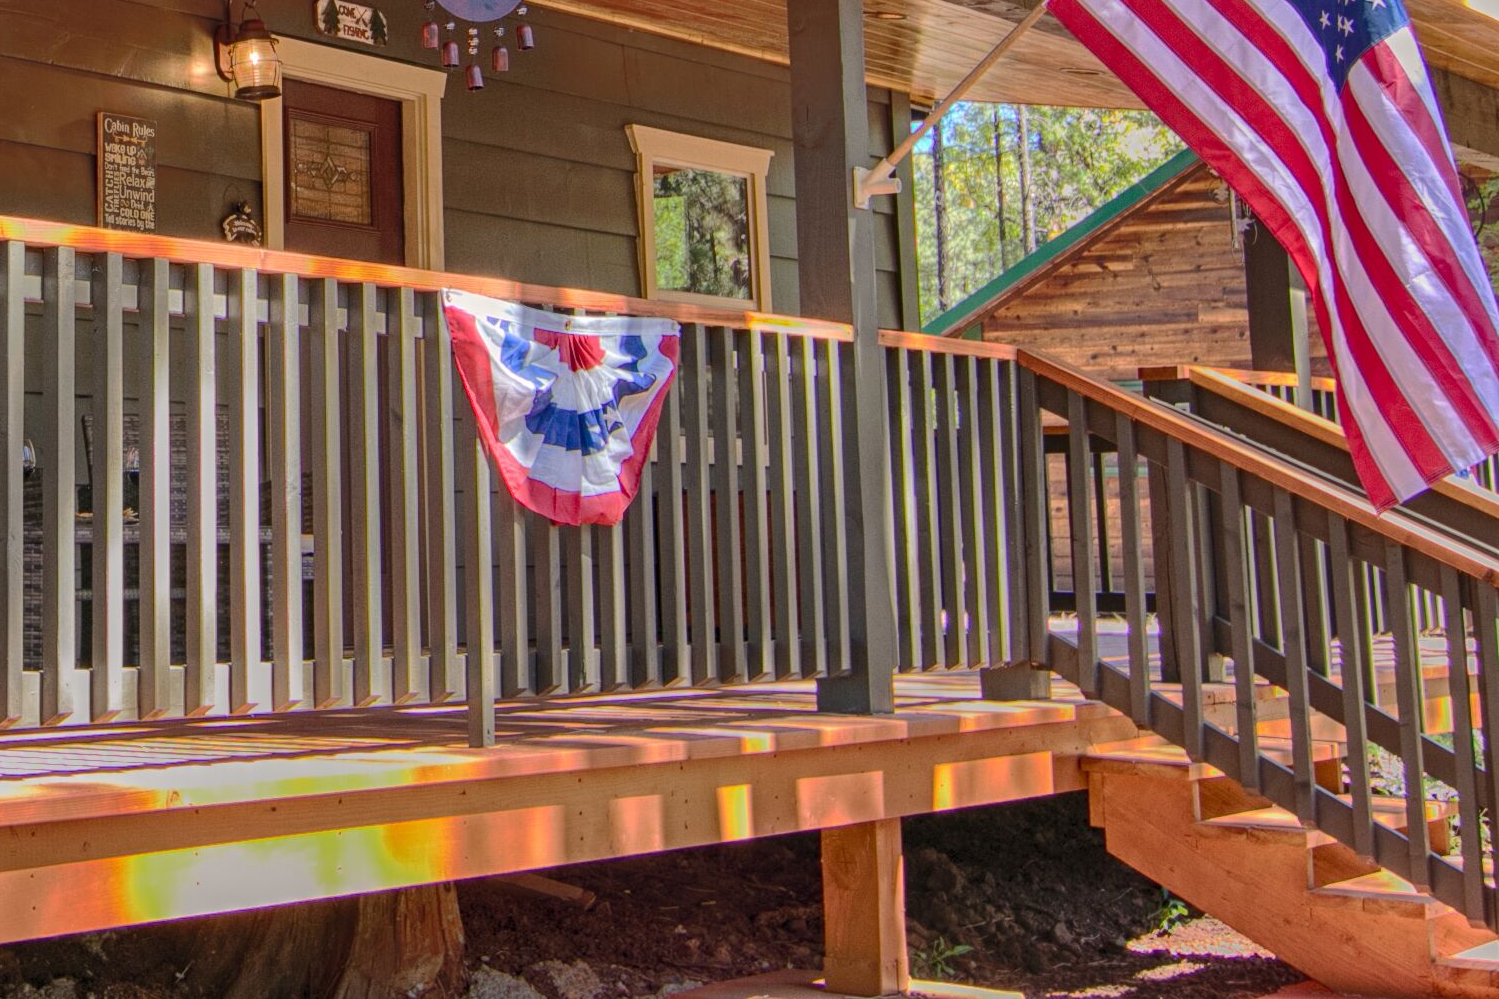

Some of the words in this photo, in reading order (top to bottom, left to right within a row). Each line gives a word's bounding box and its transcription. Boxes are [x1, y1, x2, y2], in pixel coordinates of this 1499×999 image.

[105, 118, 130, 134] Cabin
[132, 122, 155, 138] Rules
[120, 172, 145, 188] Relax
[105, 171, 113, 212] CATCH
[120, 185, 154, 202] Unwind
[120, 207, 140, 219] COLD
